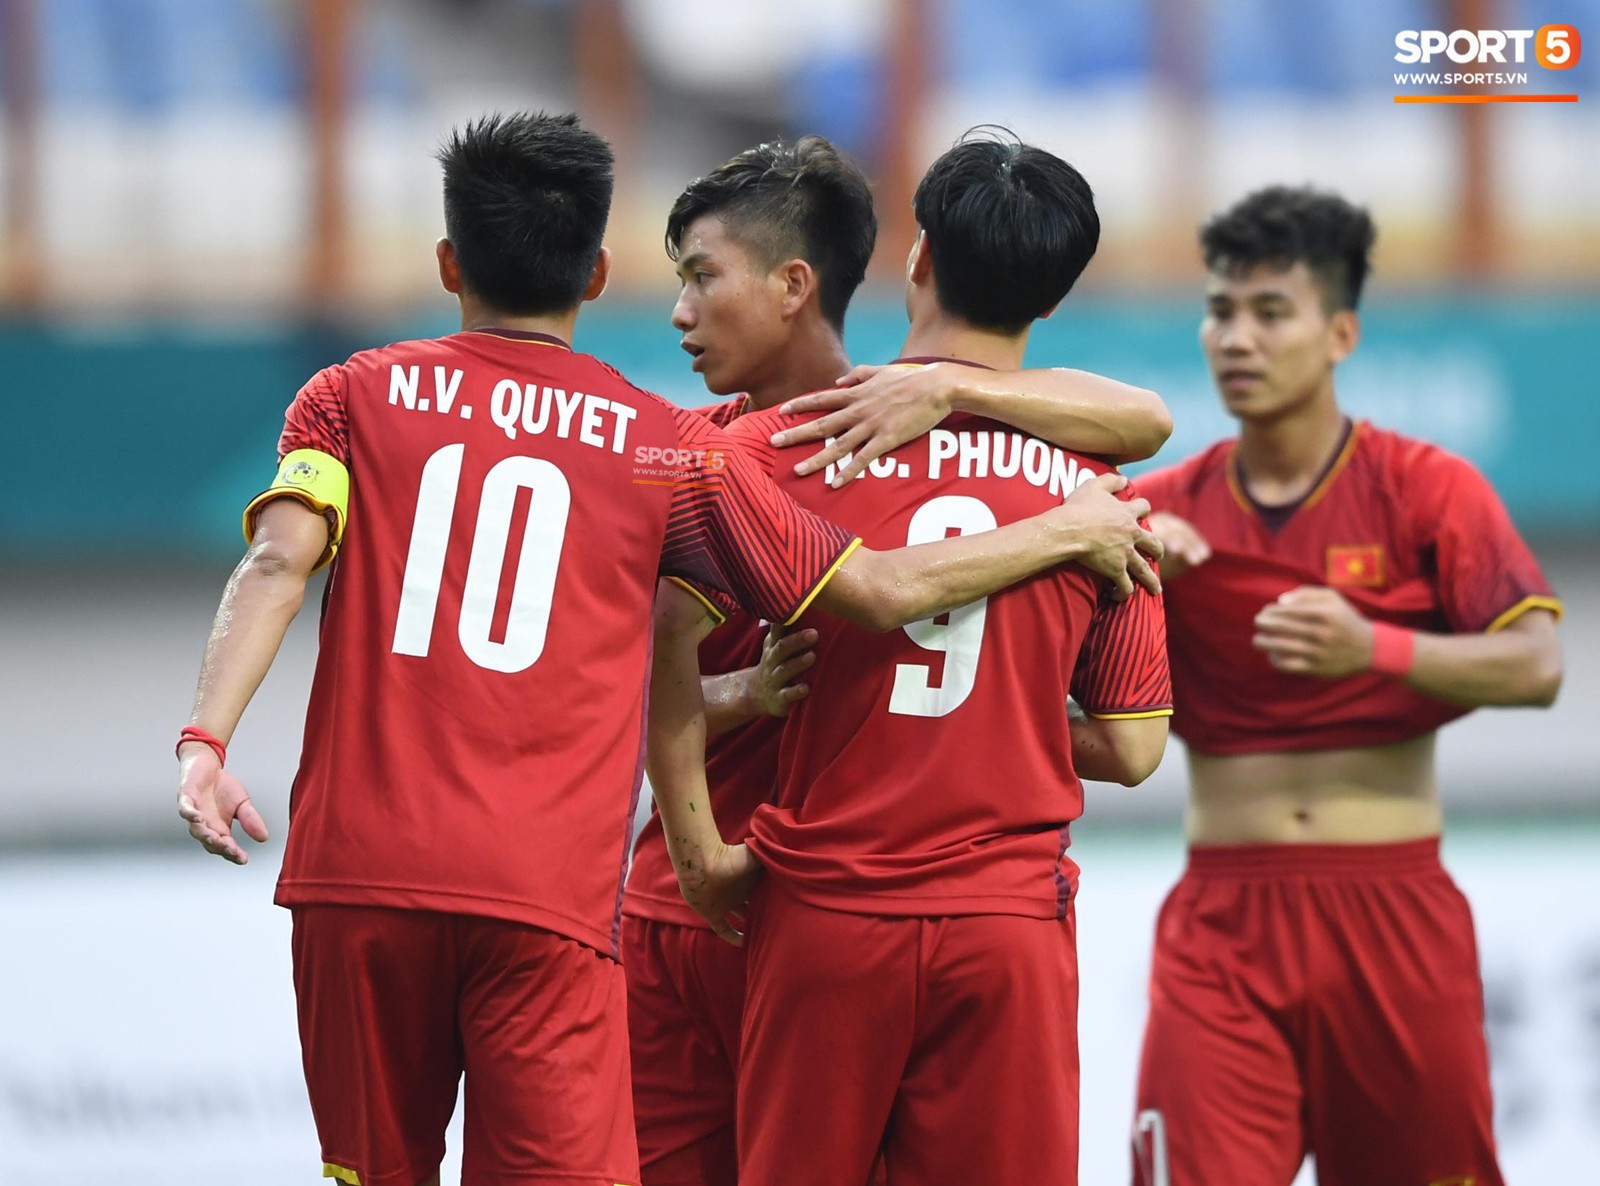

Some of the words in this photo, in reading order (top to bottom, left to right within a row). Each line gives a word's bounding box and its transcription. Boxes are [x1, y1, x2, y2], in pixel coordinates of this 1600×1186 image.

[388, 364, 473, 420] N.V.
[490, 378, 637, 454] QUYET
[391, 443, 571, 674] 10
[888, 495, 997, 718] 9
